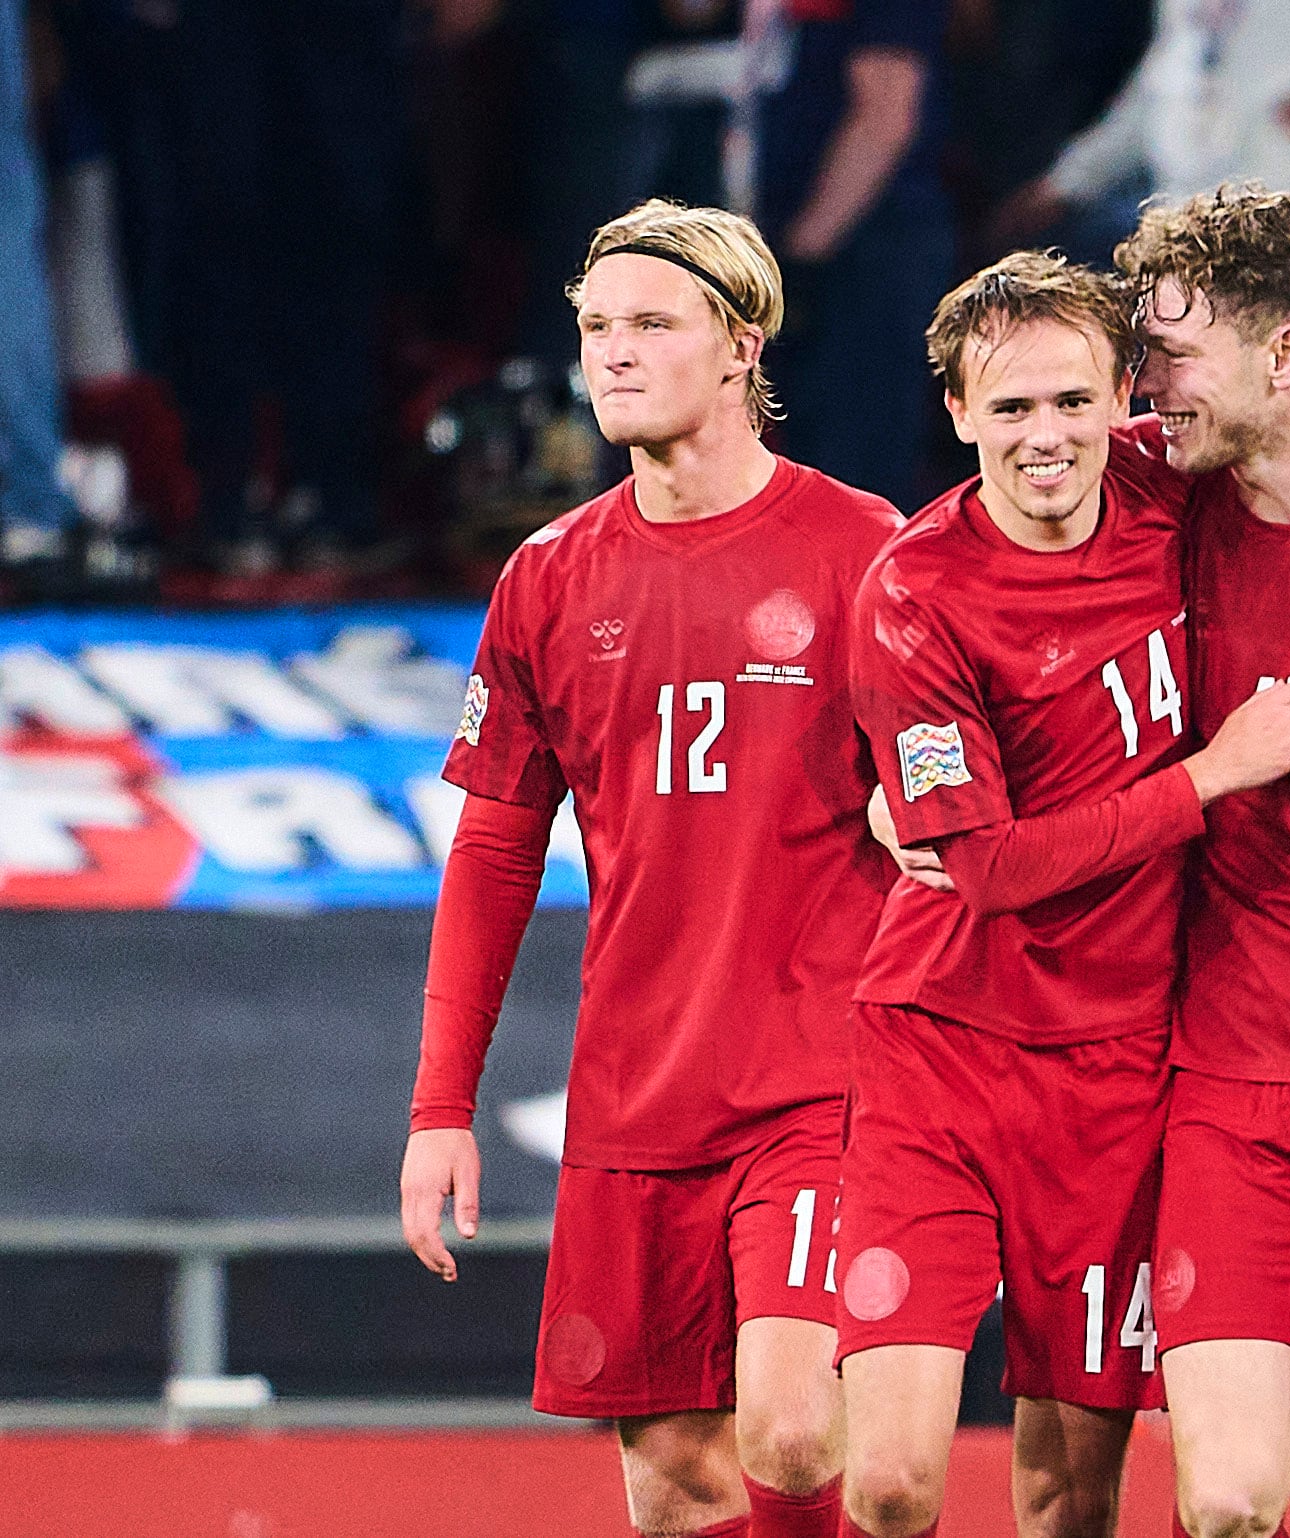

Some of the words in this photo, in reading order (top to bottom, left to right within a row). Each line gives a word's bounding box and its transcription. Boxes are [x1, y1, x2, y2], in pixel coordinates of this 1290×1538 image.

[656, 681, 727, 794] 12
[1101, 628, 1183, 758] 14
[787, 1189, 838, 1294] 1
[1081, 1262, 1158, 1373] 14
